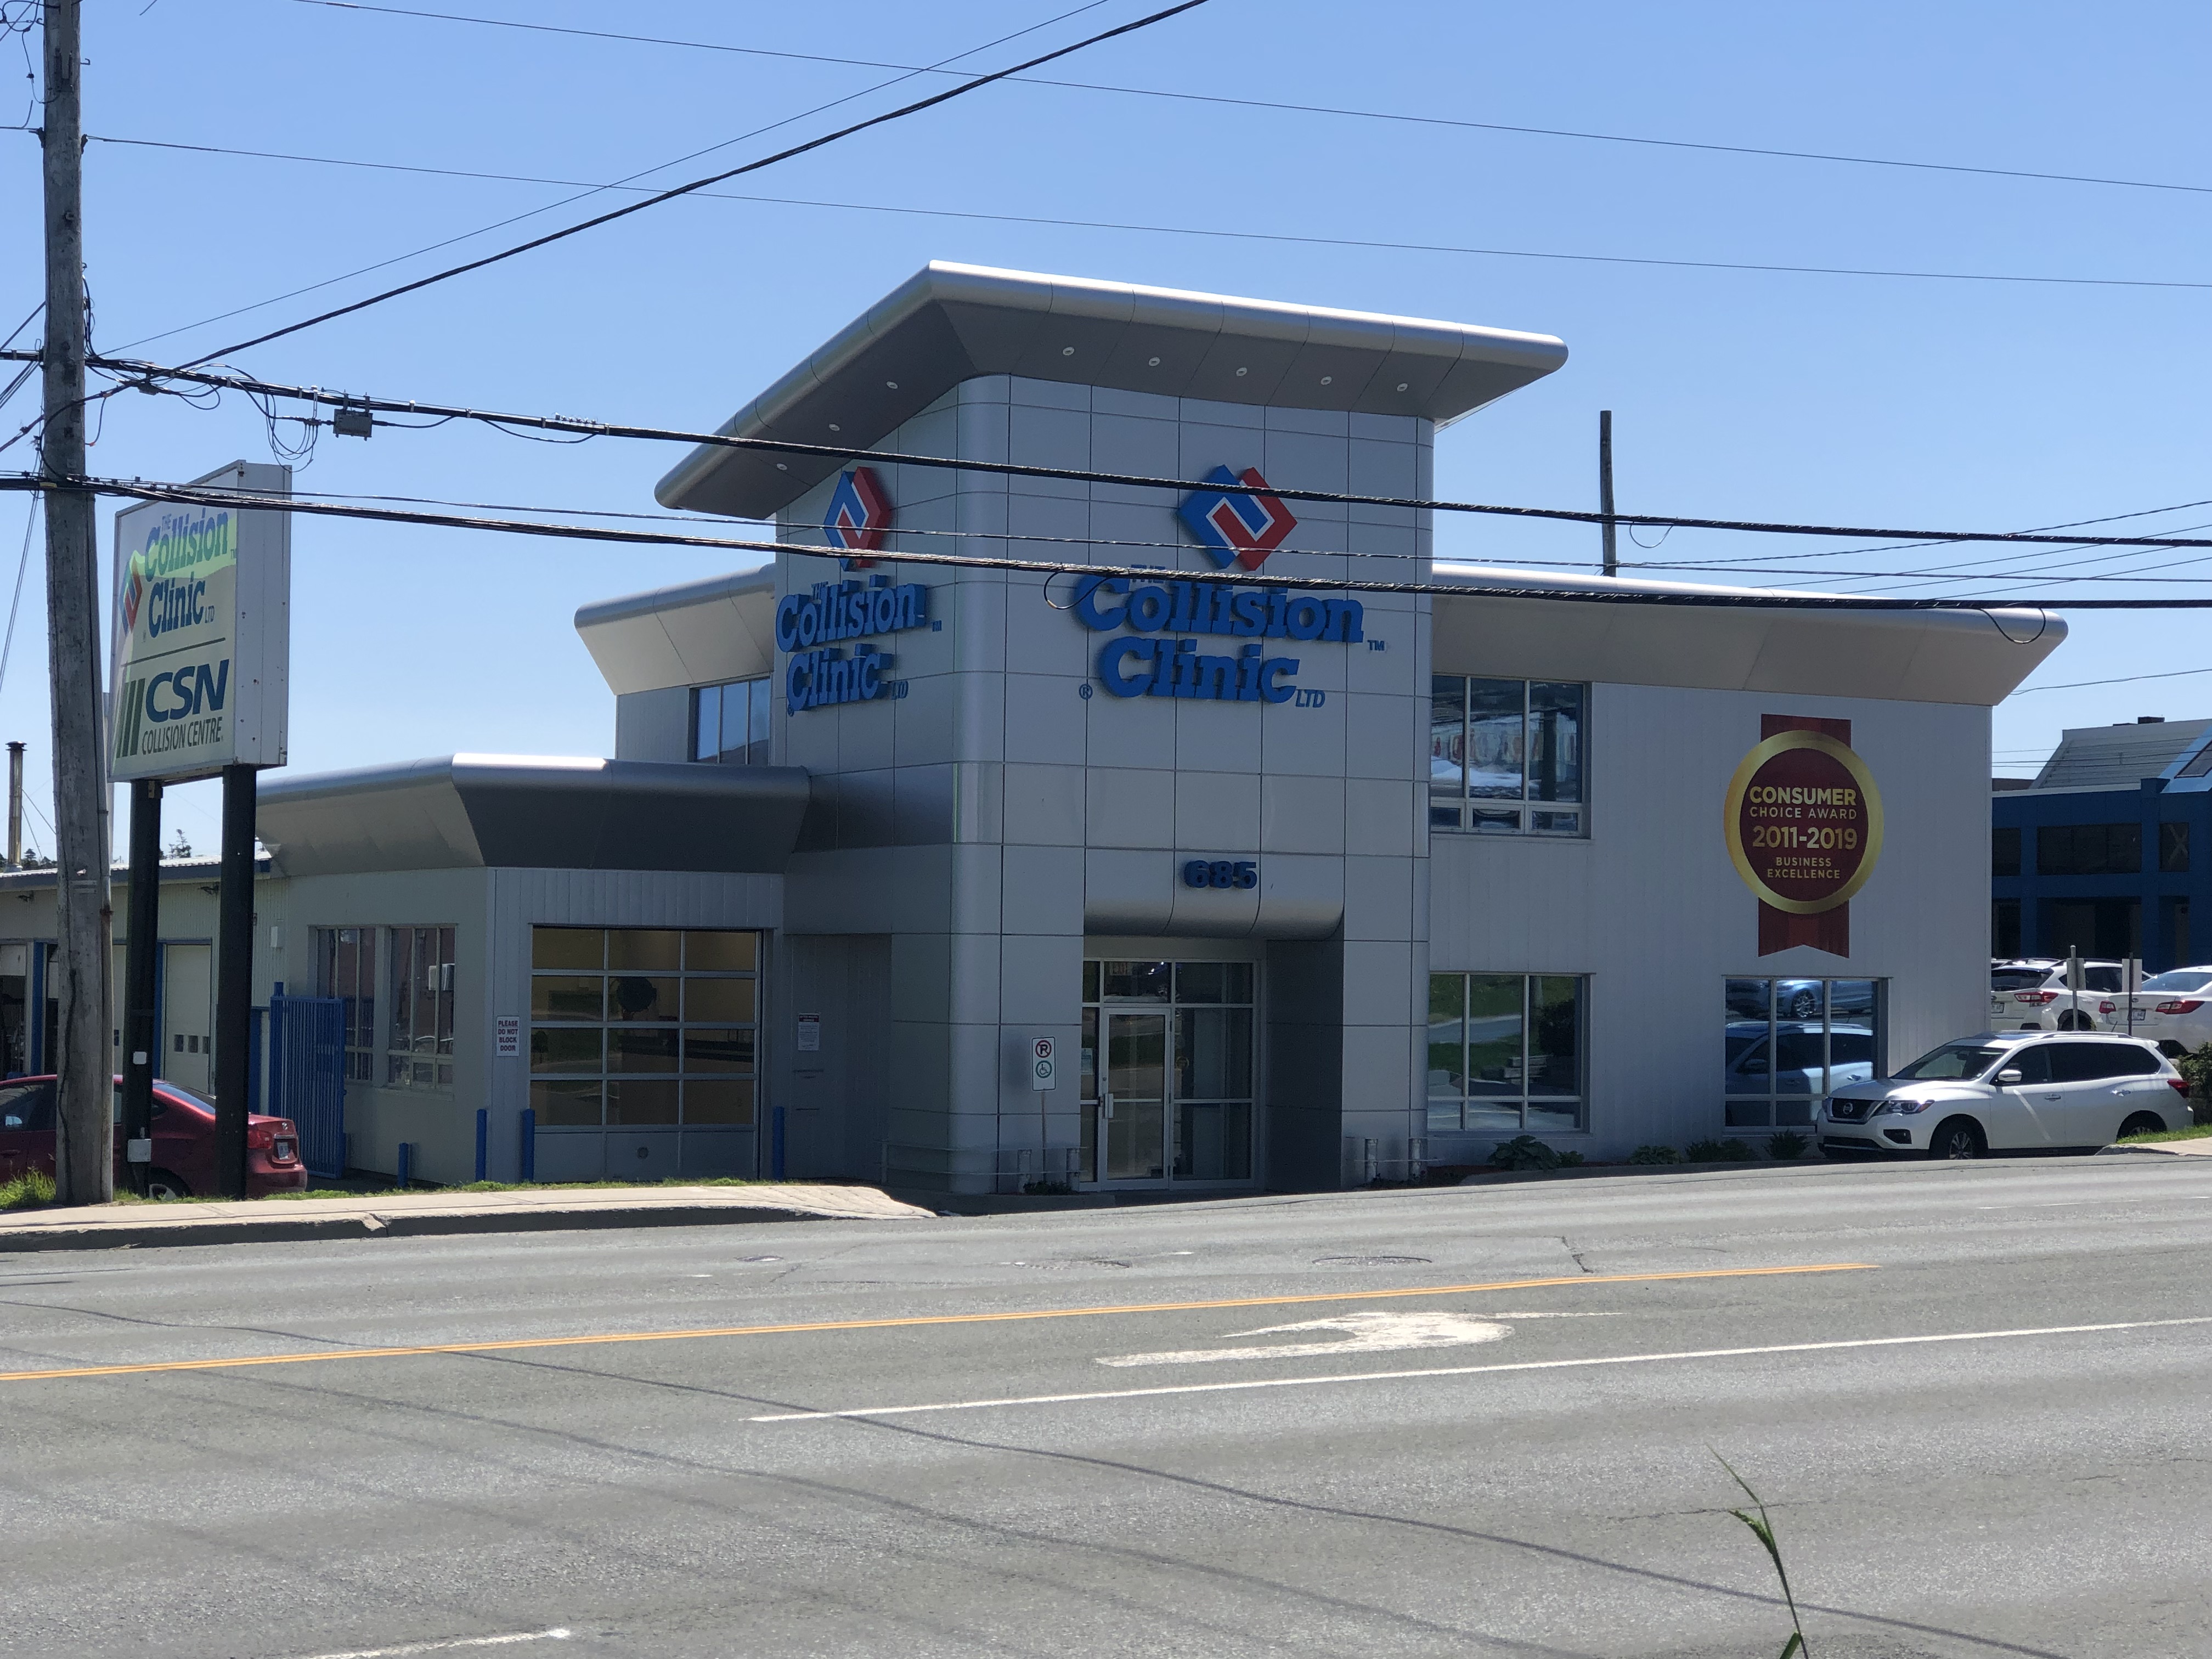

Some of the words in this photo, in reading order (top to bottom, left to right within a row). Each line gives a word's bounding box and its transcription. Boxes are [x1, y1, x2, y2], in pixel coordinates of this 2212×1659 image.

[145, 508, 229, 582] Collision
[149, 572, 206, 638] Clinic
[775, 574, 926, 652] Collision
[1074, 574, 1364, 643] Collision
[1368, 640, 1385, 652] TM
[145, 659, 230, 723] CSN
[787, 644, 890, 711] Clinic
[1098, 636, 1300, 704] Clinic
[1295, 689, 1326, 708] LTD
[142, 723, 187, 755] COLLISION
[187, 716, 223, 747] CENTRE
[1750, 786, 1857, 806] CONSUMER
[1750, 806, 1802, 818] CHOICE
[1808, 808, 1858, 820] AWARD
[1752, 825, 1858, 850] 2011-2019
[1776, 857, 1832, 867] BUSINESS
[1184, 860, 1257, 889] 685
[1767, 868, 1841, 879] EXCELLENCE
